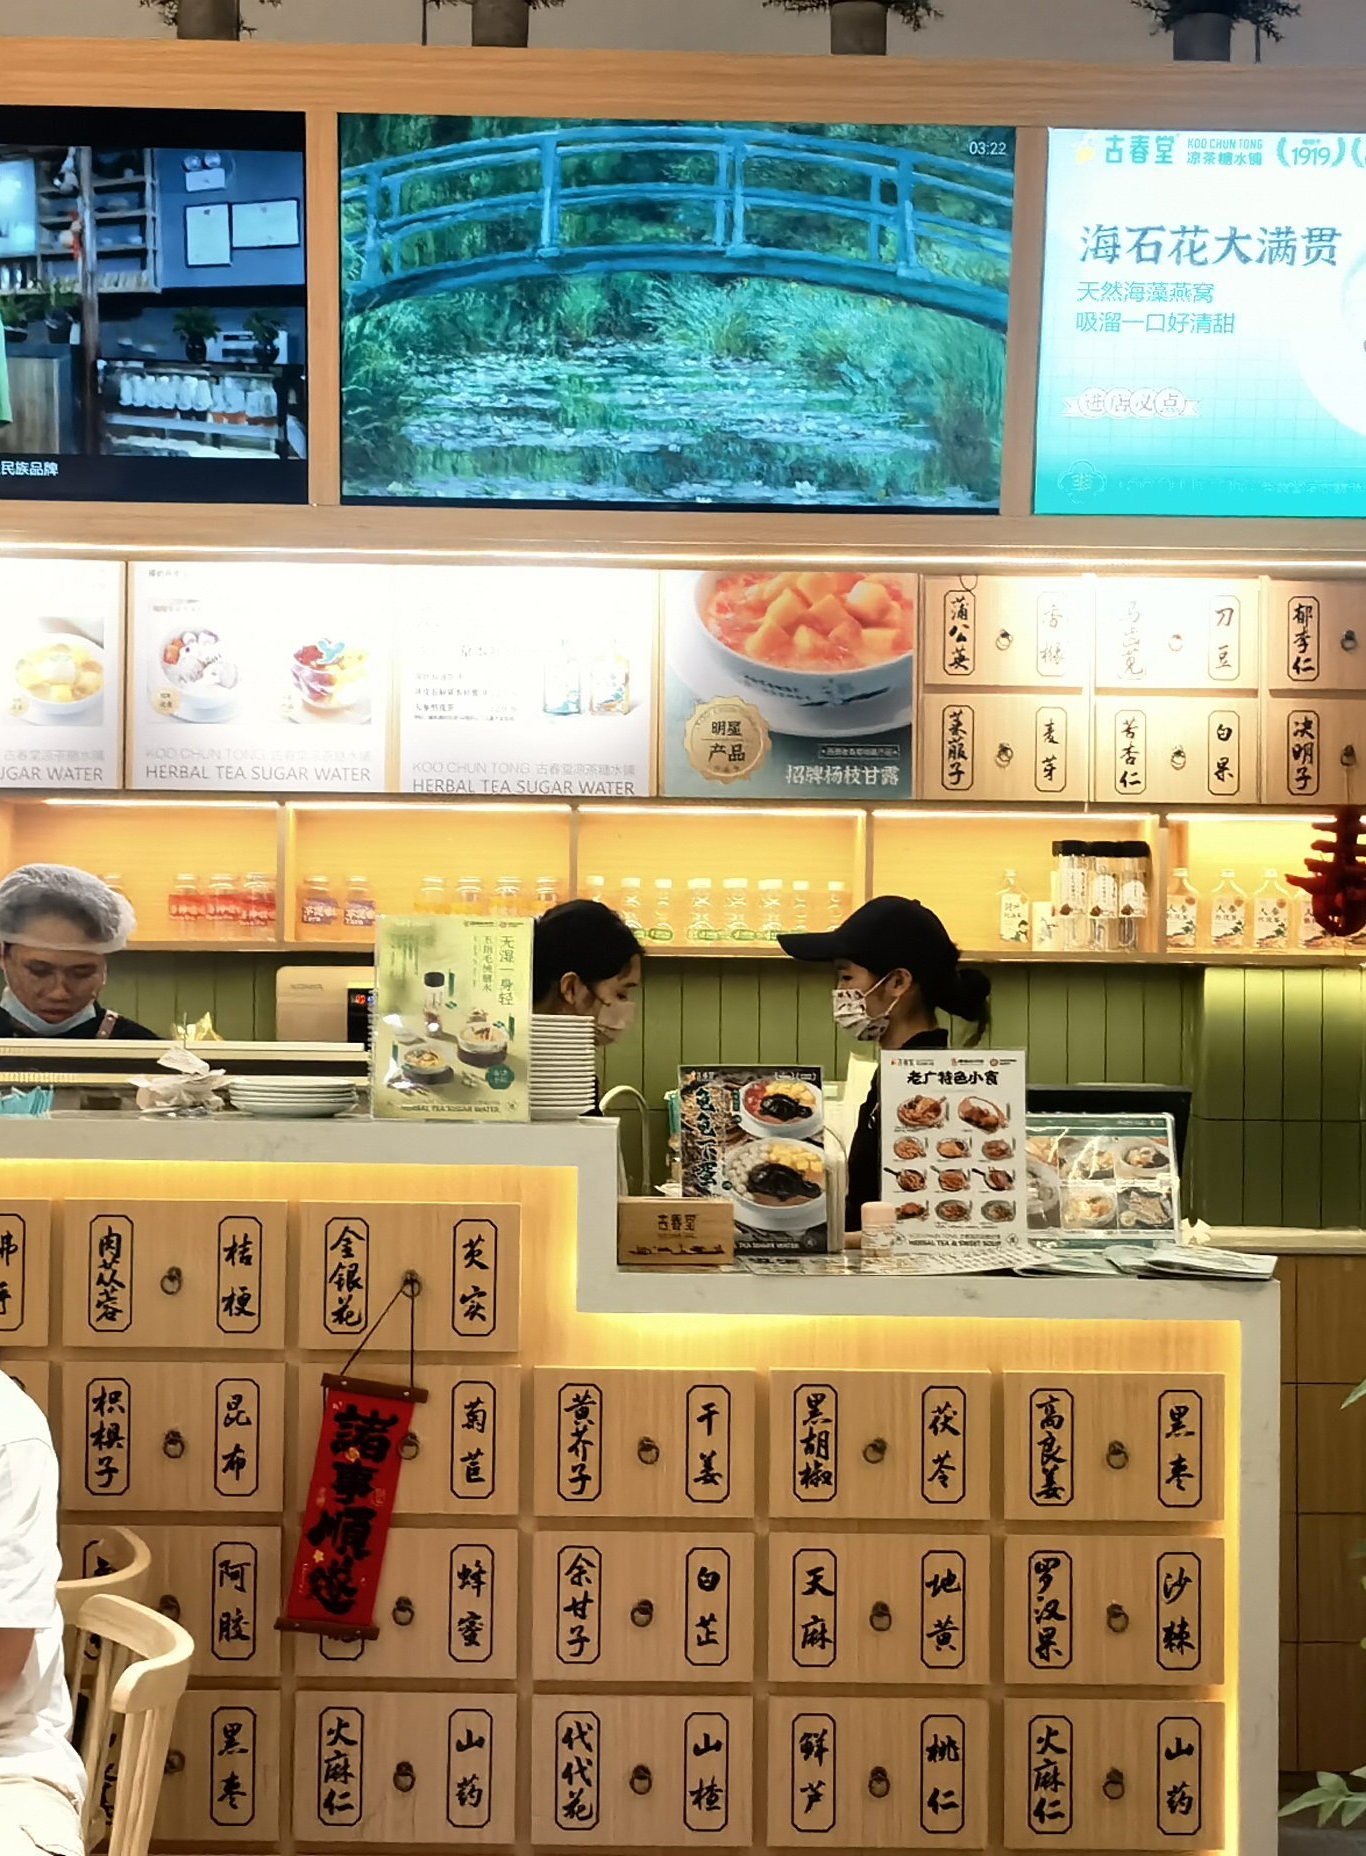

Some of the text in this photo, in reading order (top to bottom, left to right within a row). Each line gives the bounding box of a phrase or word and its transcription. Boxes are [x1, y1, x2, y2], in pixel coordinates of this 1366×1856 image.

[969, 142, 1007, 155] 03:22
[1105, 135, 1174, 164] 古春堂
[1187, 138, 1263, 150] KOO CHUN TONG
[1292, 147, 1331, 166] 1919
[1080, 223, 1342, 268] 海石花大满贯
[1076, 280, 1214, 304] 天然海藻燕窝
[1076, 309, 1235, 335] 吸溜一口好清甜
[1085, 393, 1180, 414] 进店必点
[948, 598, 970, 670] 蒲公英
[1214, 607, 1234, 669] 刀豆
[1291, 602, 1315, 673] 郁李仁
[412, 761, 443, 774] KOO
[447, 761, 486, 774] CHUN
[492, 762, 531, 774] TONG
[708, 743, 745, 762] 产品
[711, 720, 742, 737] 明星
[1041, 719, 1059, 781] 麦芽
[1119, 716, 1142, 788] 苦杏仁
[1214, 723, 1234, 781] 白果
[1291, 717, 1315, 792] 决明子
[47, 766, 104, 782] WATER
[145, 765, 371, 783] HERBAL TEA SUGAR WATER
[412, 778, 635, 796] HERBAL TEA SUGAR WATER
[785, 764, 900, 786] 招牌杨枝甘露
[499, 936, 515, 1006] 无湿一身轻
[907, 1070, 999, 1086] 老广特色小食
[96, 1226, 126, 1322] 肉苁蓉
[221, 1234, 256, 1317] 桔梗
[328, 1226, 365, 1327] 金银花
[460, 1233, 489, 1322] 芡实
[221, 1393, 251, 1481] 昆布
[460, 1397, 488, 1485] 菊苣
[564, 1393, 597, 1495] 黄芥子
[693, 1402, 722, 1486] 干姜
[798, 1393, 833, 1489] 黑胡椒
[928, 1402, 961, 1489] 茯苓
[1035, 1394, 1067, 1501] 高良姜
[1164, 1405, 1195, 1492] 黑枣
[218, 1559, 252, 1643] 阿胶
[457, 1559, 487, 1648] 蜂蜜
[563, 1553, 597, 1657] 余甘子
[695, 1565, 722, 1647] 白芷
[800, 1565, 834, 1650] 天麻
[925, 1568, 962, 1653] 地黄
[1034, 1557, 1066, 1662] 罗汉果
[1162, 1566, 1195, 1656] 沙棘
[217, 1722, 249, 1810] 黑枣
[322, 1717, 358, 1816] 火麻仁
[455, 1729, 485, 1808] 山药
[561, 1722, 594, 1822] 代代花
[690, 1732, 723, 1813] 山楂
[798, 1728, 829, 1814] 鲜芦
[925, 1734, 960, 1815] 桃仁
[1033, 1724, 1068, 1824] 火麻仁
[1164, 1736, 1195, 1816] 山药
